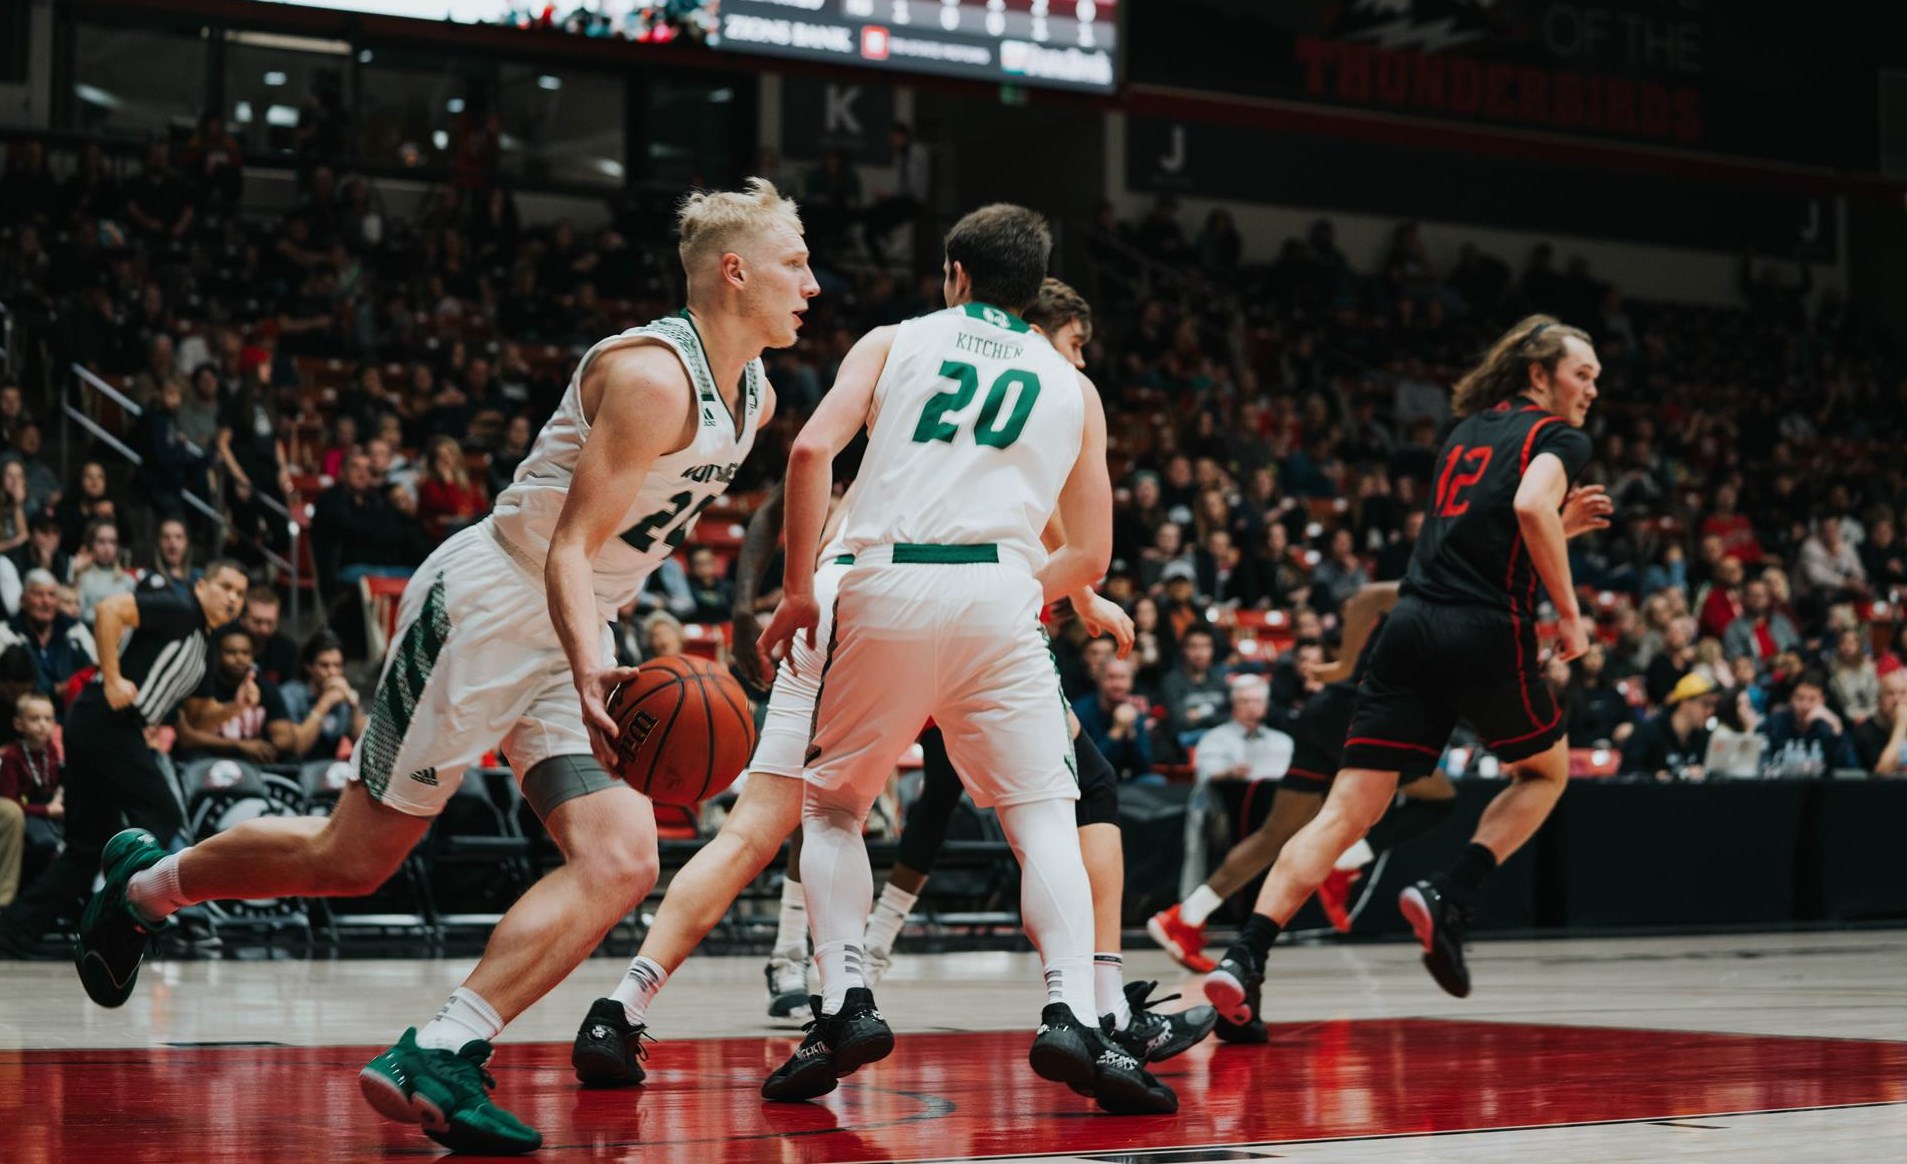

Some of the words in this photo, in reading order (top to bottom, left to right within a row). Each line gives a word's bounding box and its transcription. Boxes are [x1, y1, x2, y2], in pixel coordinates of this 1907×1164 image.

[1543, 4, 1611, 58] OF
[1616, 11, 1700, 73] THE
[823, 84, 865, 135] K
[1295, 36, 1702, 142] THUNDERBIRDS
[1158, 124, 1188, 174] J
[955, 331, 1024, 361] KITCHEN
[911, 360, 1041, 450] 20
[1433, 444, 1493, 518] 12
